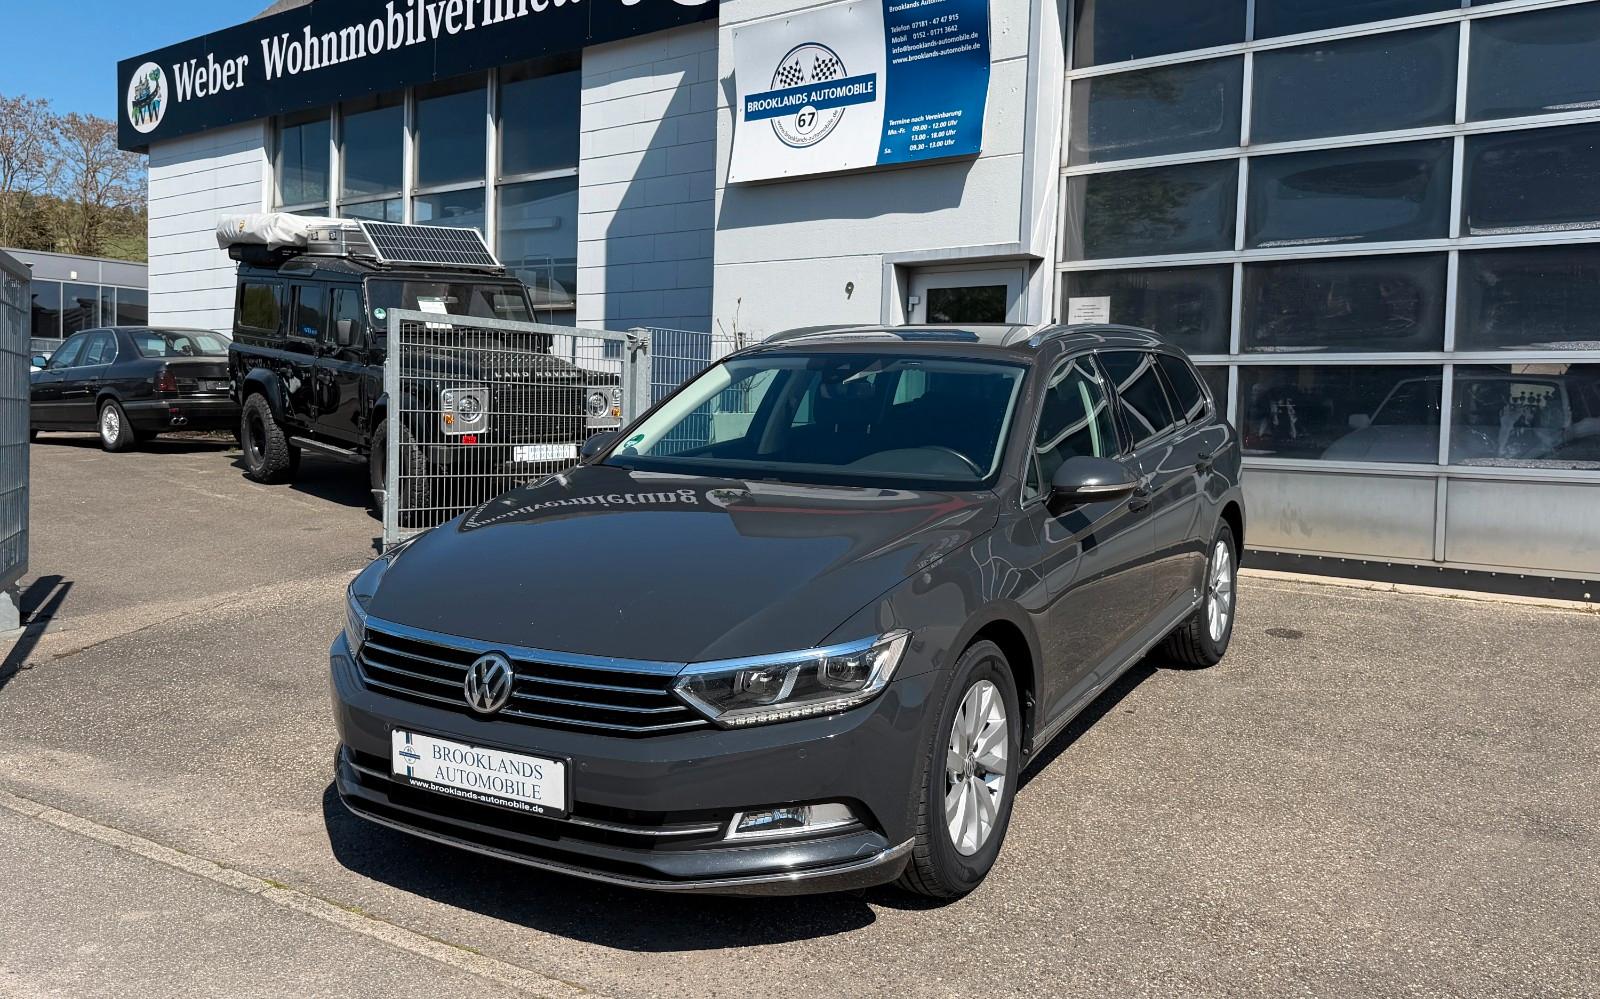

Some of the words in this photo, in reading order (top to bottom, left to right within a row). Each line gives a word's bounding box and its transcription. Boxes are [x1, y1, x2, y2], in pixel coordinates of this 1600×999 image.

[889, 1, 920, 12] Brooklands
[891, 24, 911, 33] Telefon
[911, 20, 928, 29] 07181
[932, 17, 940, 25] 47
[940, 15, 948, 23] 47
[948, 13, 959, 21] 915
[891, 34, 907, 44] Mobil
[912, 31, 926, 40] 0152
[892, 32, 979, 54] info@brooklands-automobile.de
[892, 43, 981, 65] www.brooklands-automobile.de
[173, 52, 249, 103] Weber
[747, 92, 808, 113] BROOKLANDS
[810, 81, 874, 102] AUTOMOBILE
[797, 112, 816, 128] 67
[889, 118, 911, 126] Termine
[925, 110, 962, 121] Vereinbarung
[912, 124, 928, 132] 09.00
[932, 121, 947, 129] 12.00
[911, 133, 926, 141] 13.00
[845, 281, 855, 300] 9
[432, 744, 544, 780] BROOKLANDS
[435, 765, 542, 800] AUTOMOBILE
[409, 778, 544, 814] www.brooklands-automobile.de
